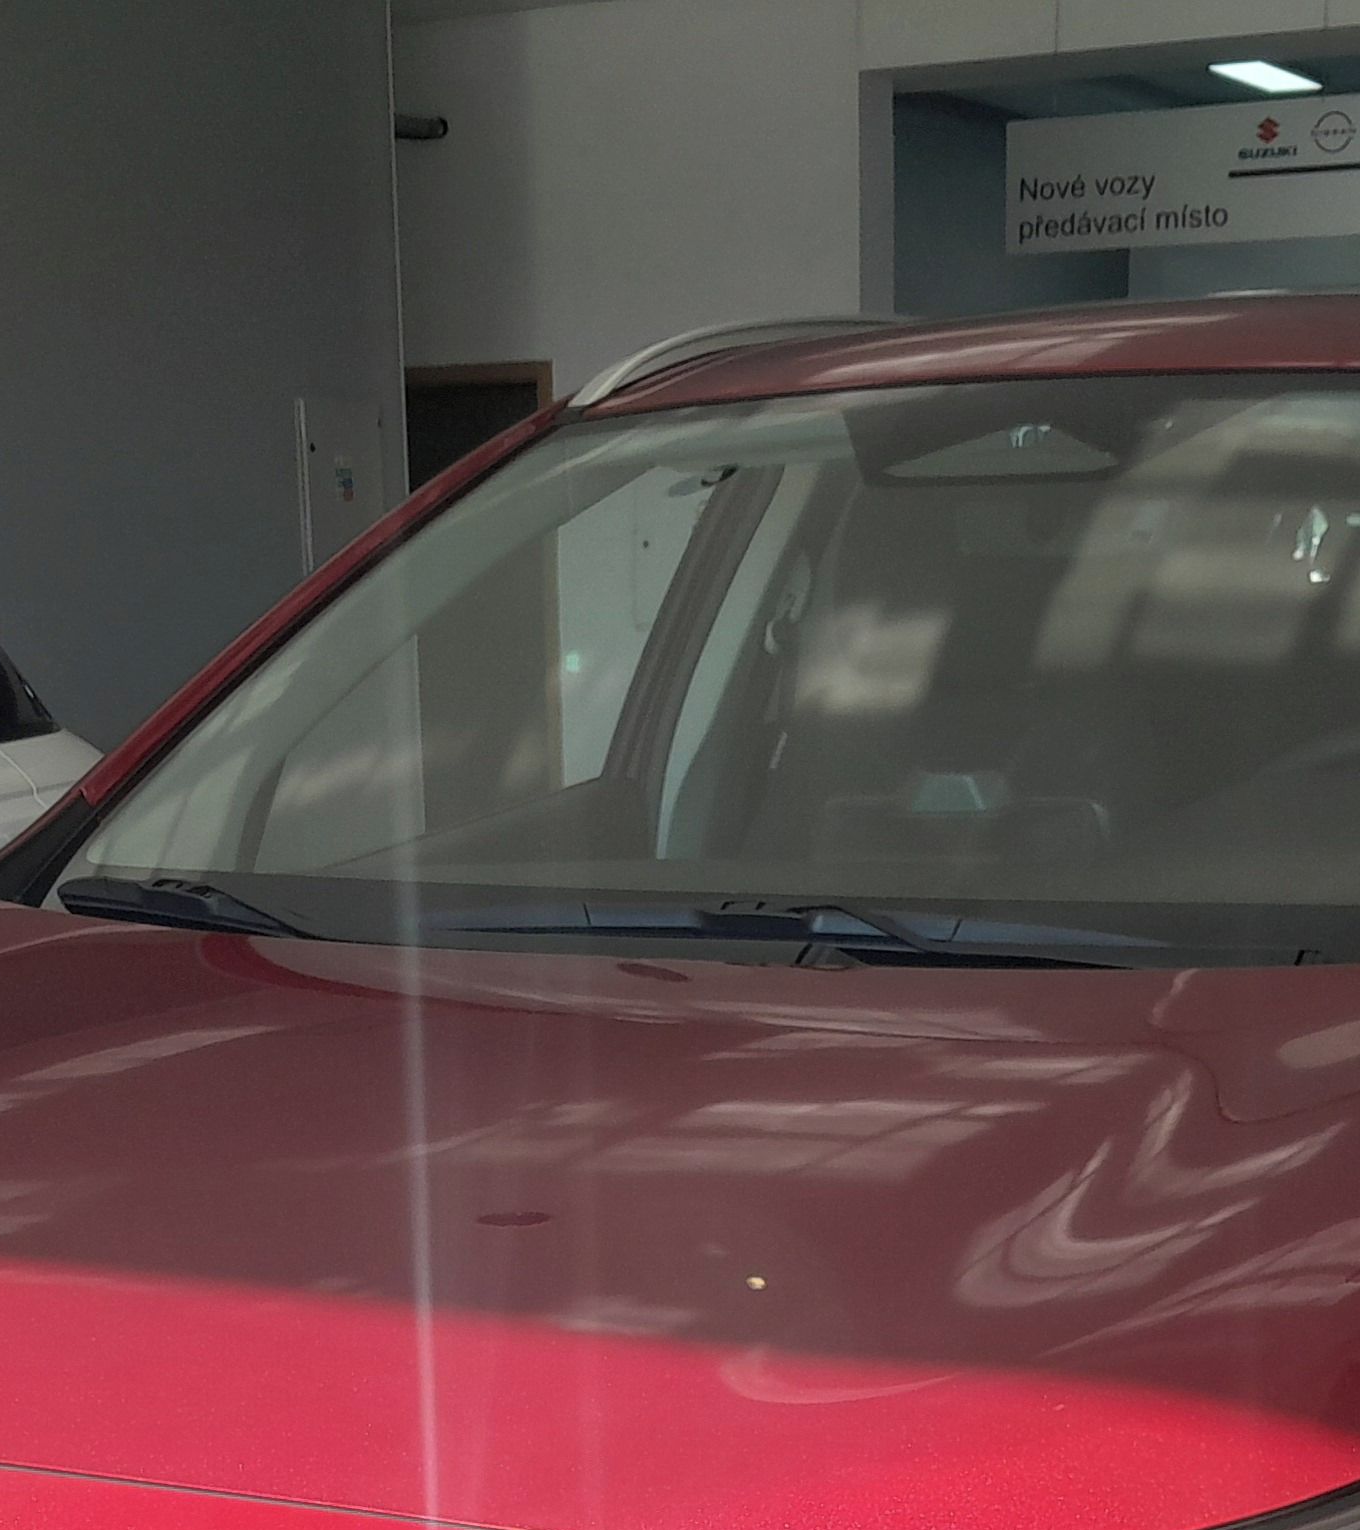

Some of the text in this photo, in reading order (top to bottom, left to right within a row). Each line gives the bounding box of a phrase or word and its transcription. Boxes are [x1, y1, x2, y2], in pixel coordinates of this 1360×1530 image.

[1019, 174, 1156, 201] Nové vozy
[1019, 204, 1228, 244] předávací místo
